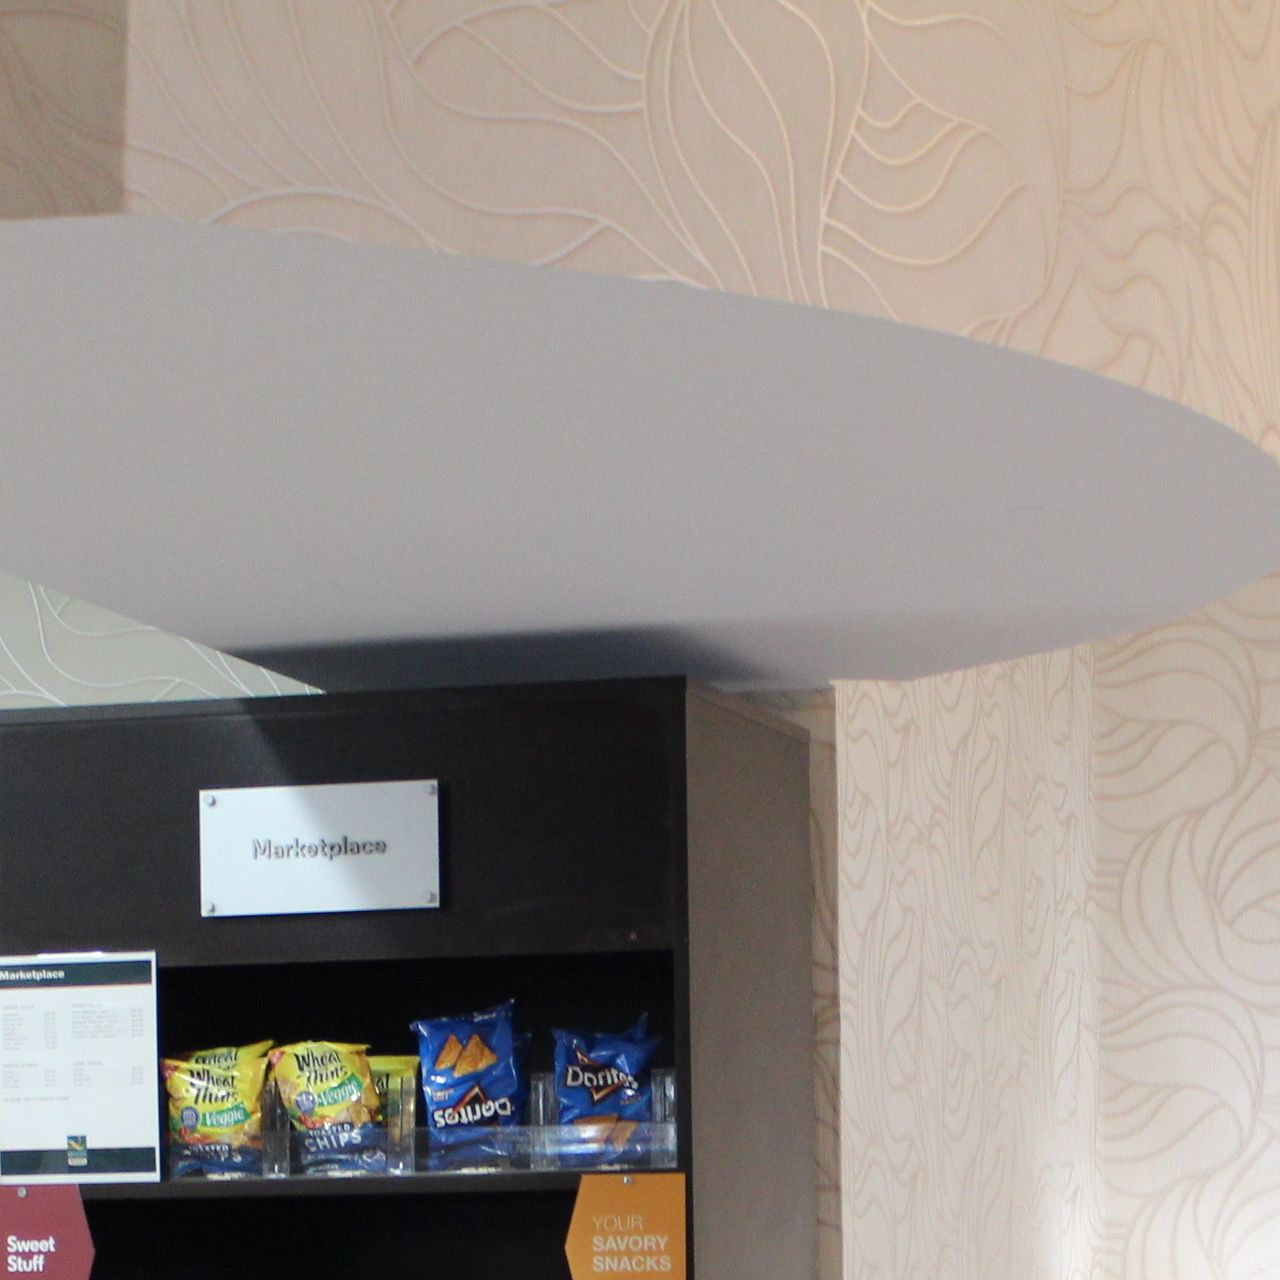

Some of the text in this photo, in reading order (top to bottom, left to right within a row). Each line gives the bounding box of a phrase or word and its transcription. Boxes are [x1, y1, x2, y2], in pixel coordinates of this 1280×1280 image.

[252, 835, 388, 861] Marketplace
[295, 1047, 343, 1072] Wheat
[188, 1069, 238, 1089] Wheat
[305, 1066, 348, 1089] Thins
[566, 1065, 640, 1090] Doritos
[319, 1079, 361, 1106] Veggie
[204, 1107, 246, 1128] Veggie
[432, 1098, 512, 1128] Doritos
[304, 1130, 363, 1153] CHIPS
[592, 1215, 644, 1232] YOUR
[7, 1235, 56, 1253] Sweet
[592, 1235, 669, 1252] SAVORY
[7, 1254, 45, 1272] Stuff
[592, 1255, 672, 1272] SNACKS
